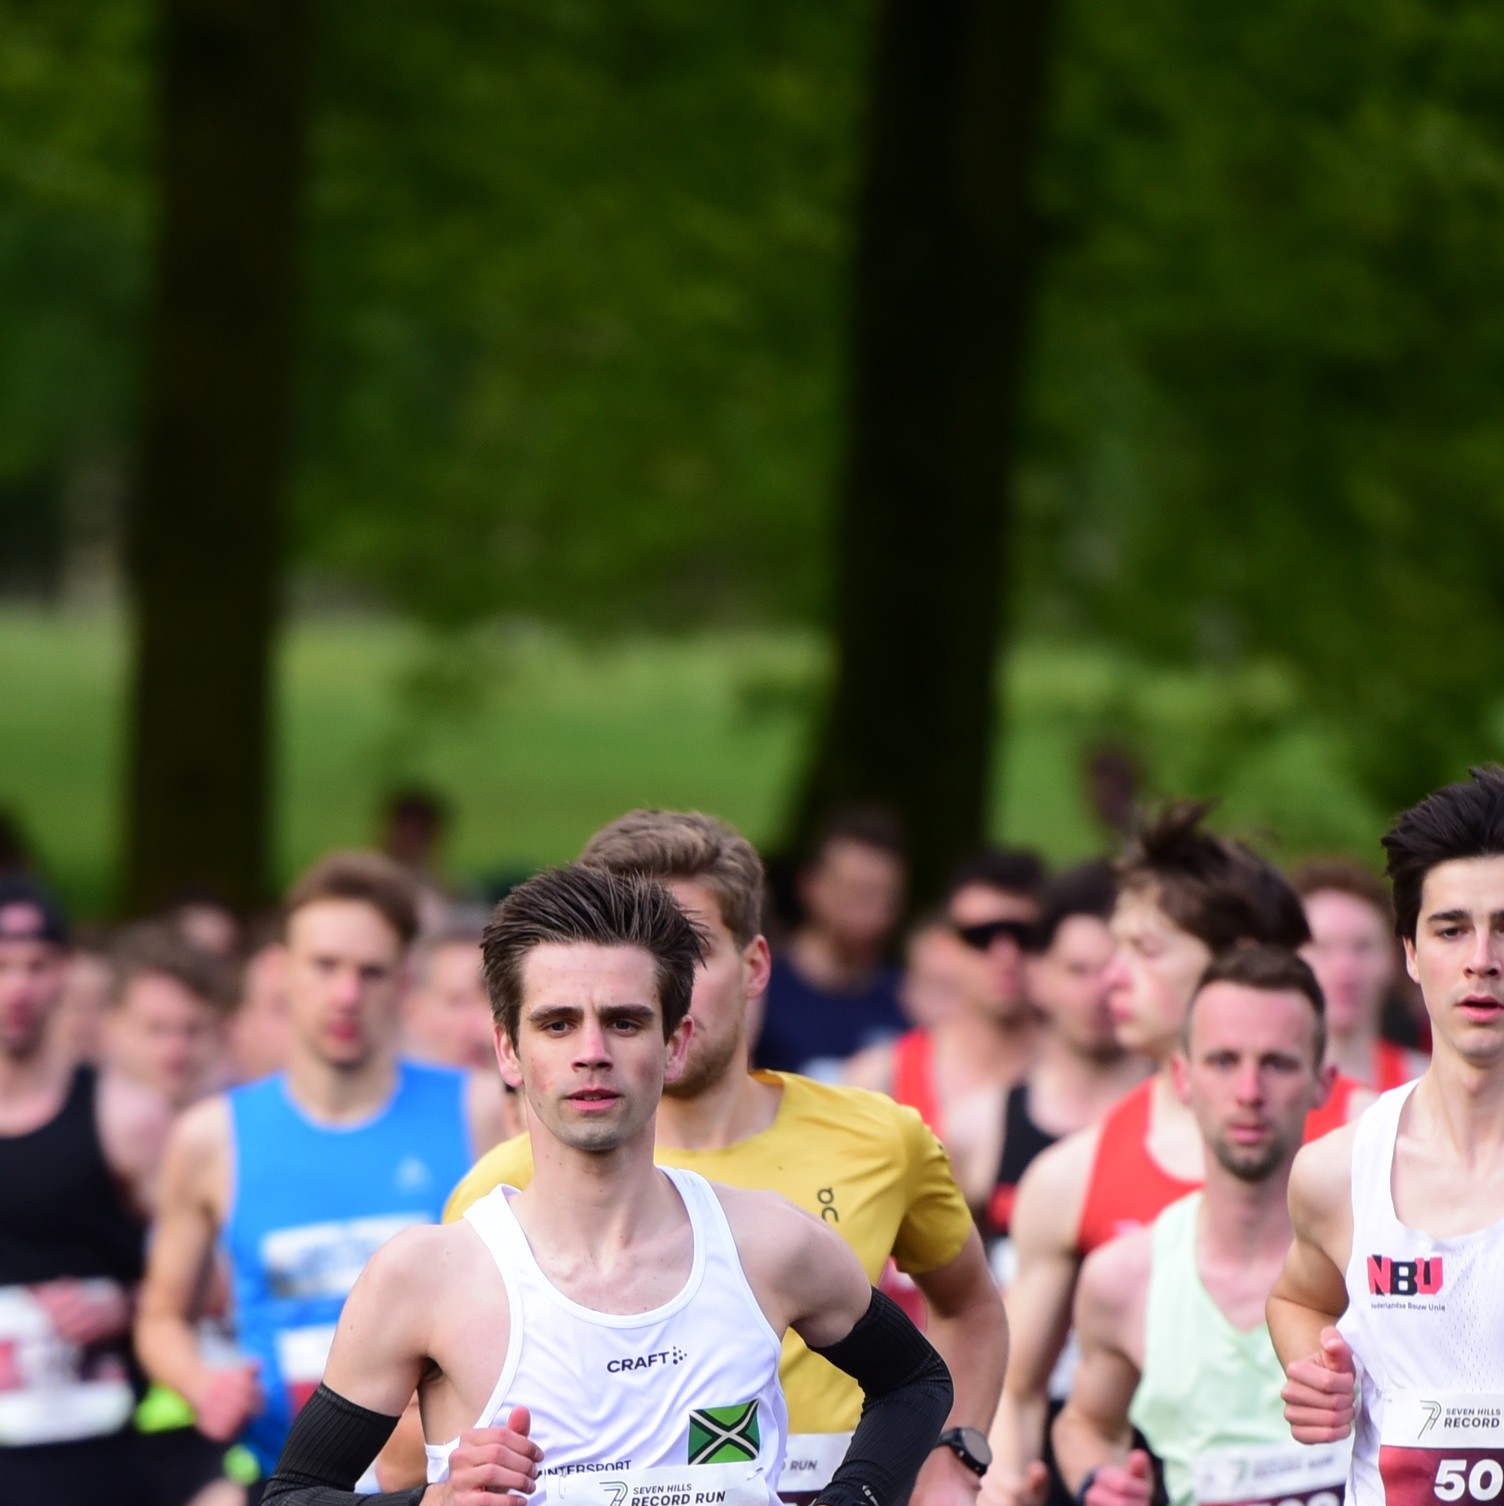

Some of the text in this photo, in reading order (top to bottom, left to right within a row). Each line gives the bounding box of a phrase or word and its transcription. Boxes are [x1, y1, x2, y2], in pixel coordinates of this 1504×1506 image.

[1366, 1254, 1444, 1297] NBU
[606, 1351, 670, 1374] CRAFT
[1445, 1408, 1502, 1416] SEVEN HILLS
[1443, 1416, 1501, 1429] RECORD
[789, 1460, 818, 1471] RUN
[632, 1483, 693, 1496] SEVEN HILLS
[695, 1490, 727, 1505] RUN
